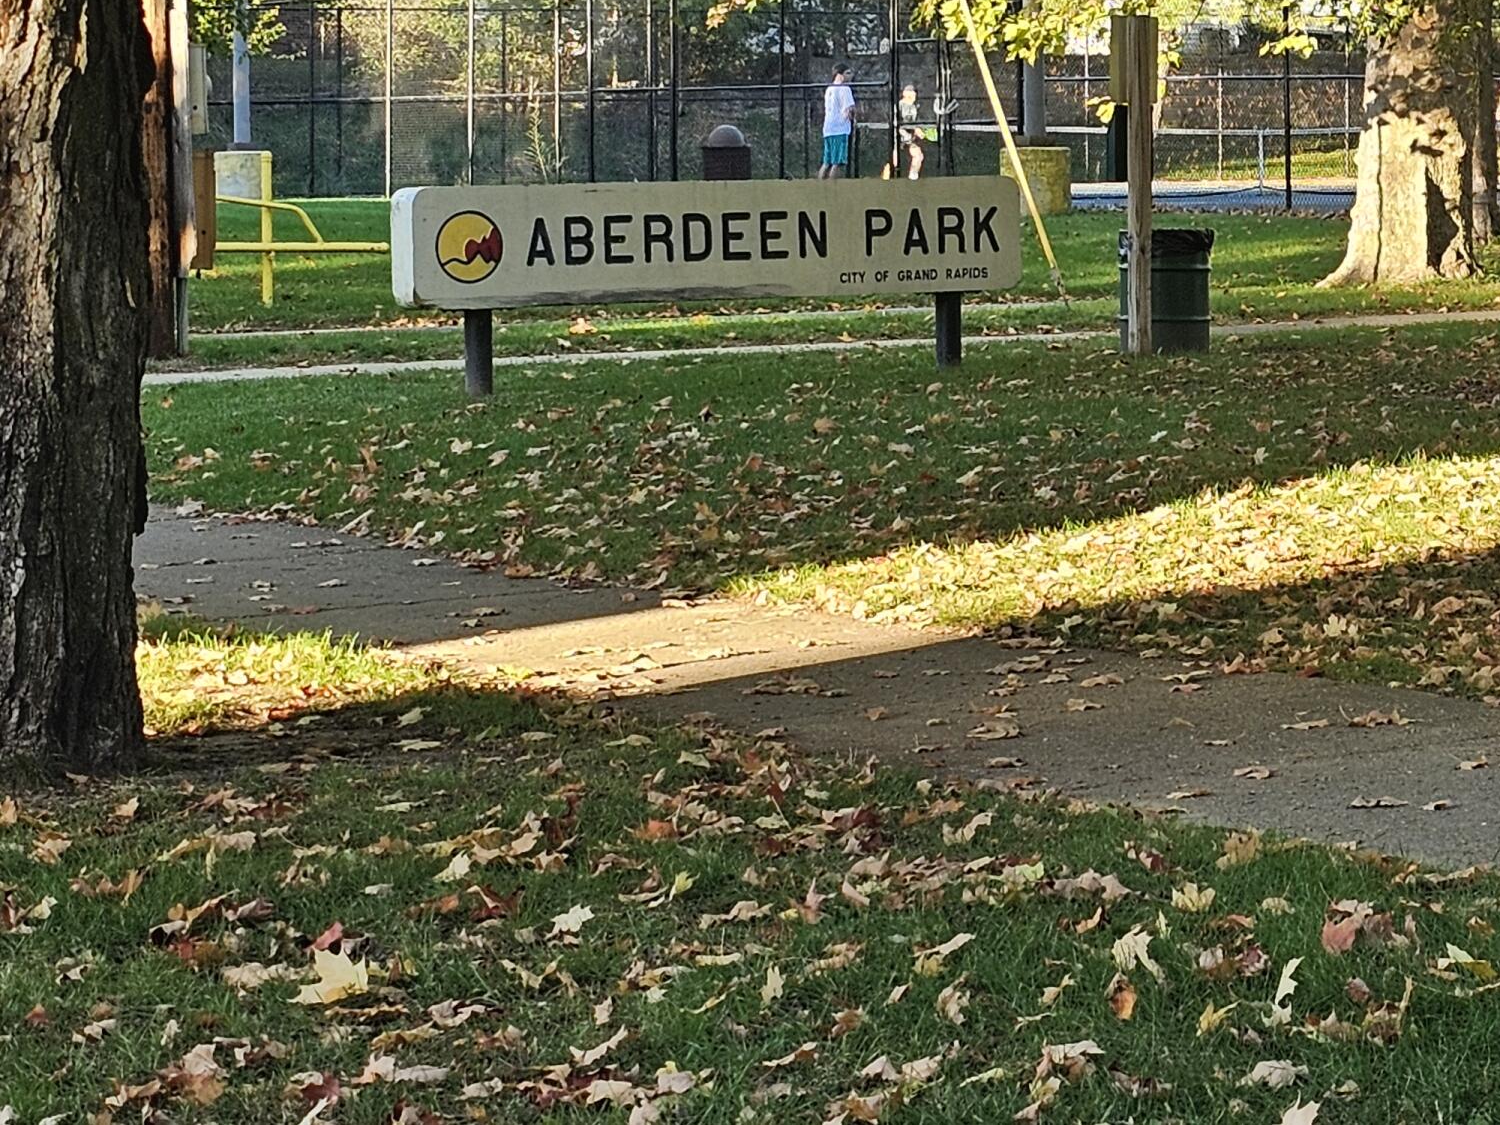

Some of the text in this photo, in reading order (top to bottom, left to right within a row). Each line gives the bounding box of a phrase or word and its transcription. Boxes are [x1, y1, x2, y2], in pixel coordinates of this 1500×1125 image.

[526, 205, 1001, 267] ABERDEEN PARK
[839, 267, 989, 284] CITY OF GRAND RAPIDS
